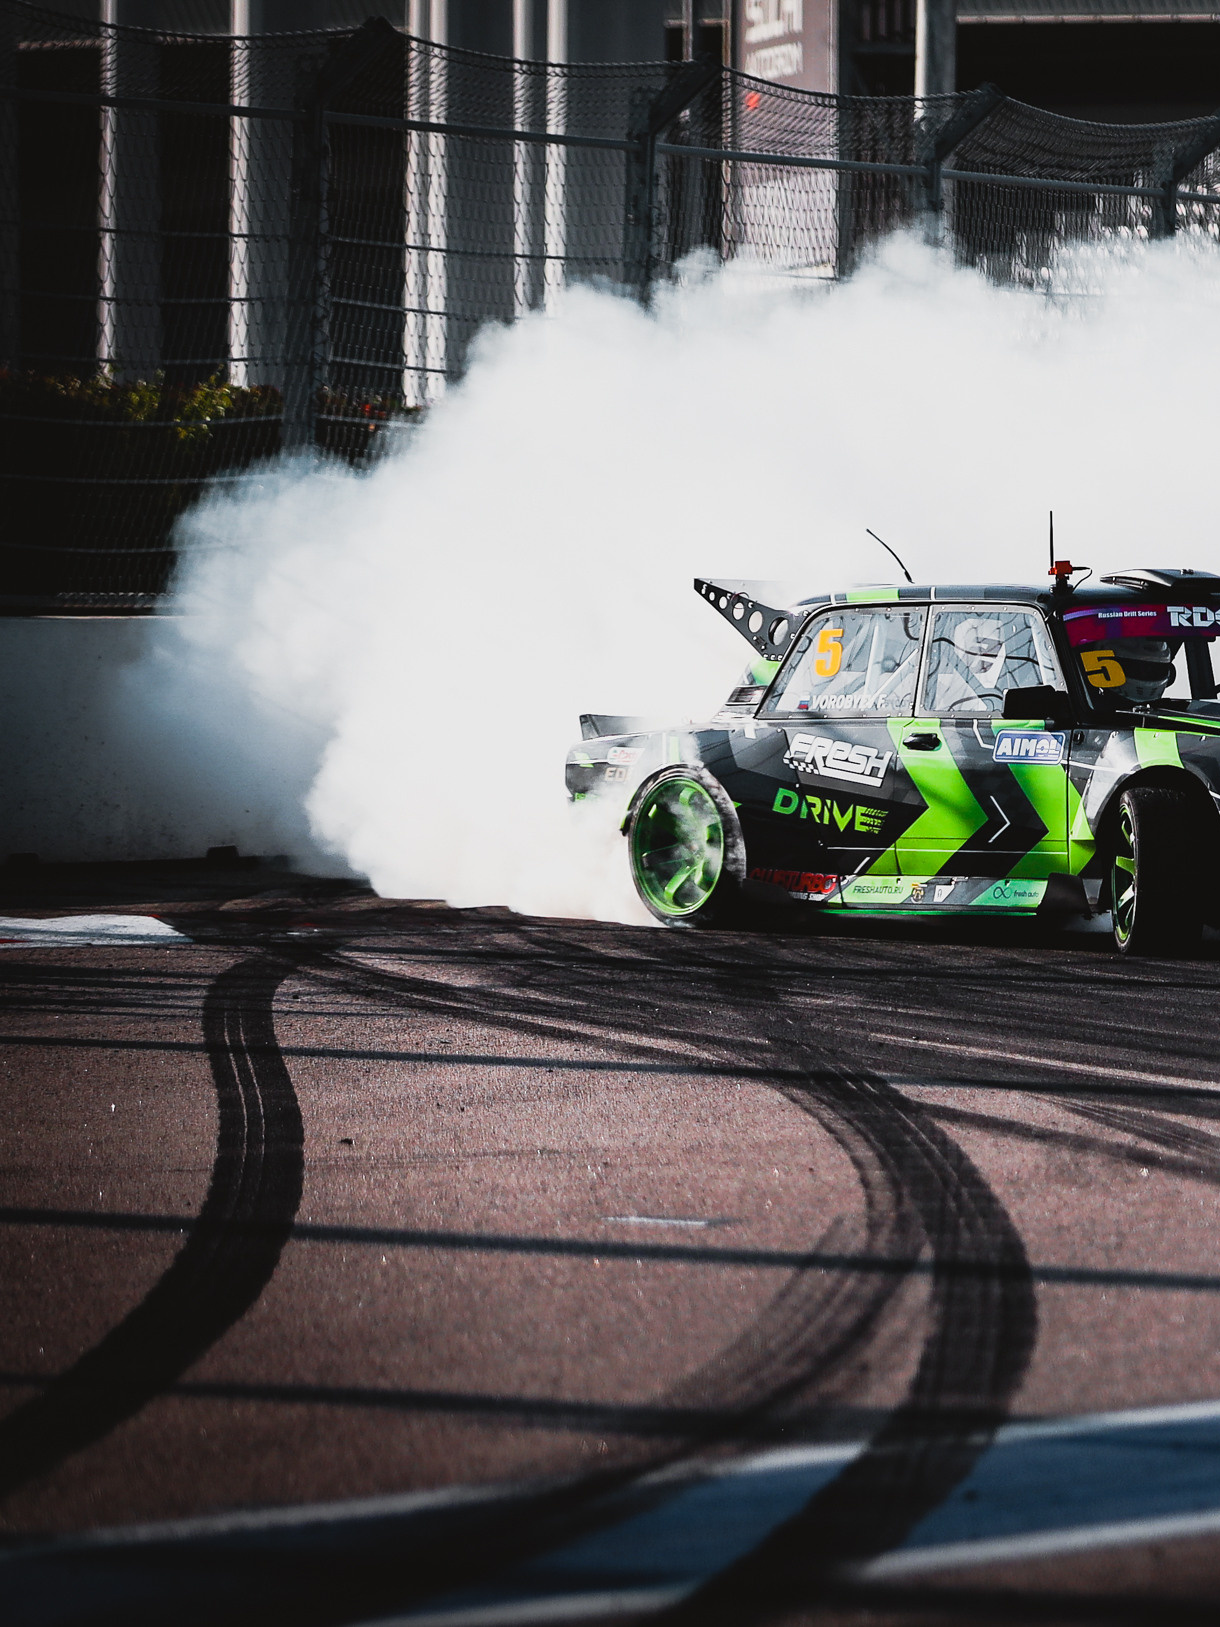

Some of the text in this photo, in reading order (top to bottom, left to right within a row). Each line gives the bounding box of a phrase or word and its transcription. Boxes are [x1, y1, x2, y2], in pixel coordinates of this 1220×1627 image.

[814, 628, 844, 678] 5
[1080, 650, 1126, 688] 5
[996, 737, 1061, 758] AIMOL
[853, 885, 904, 894] FRESHAUTO.RU
